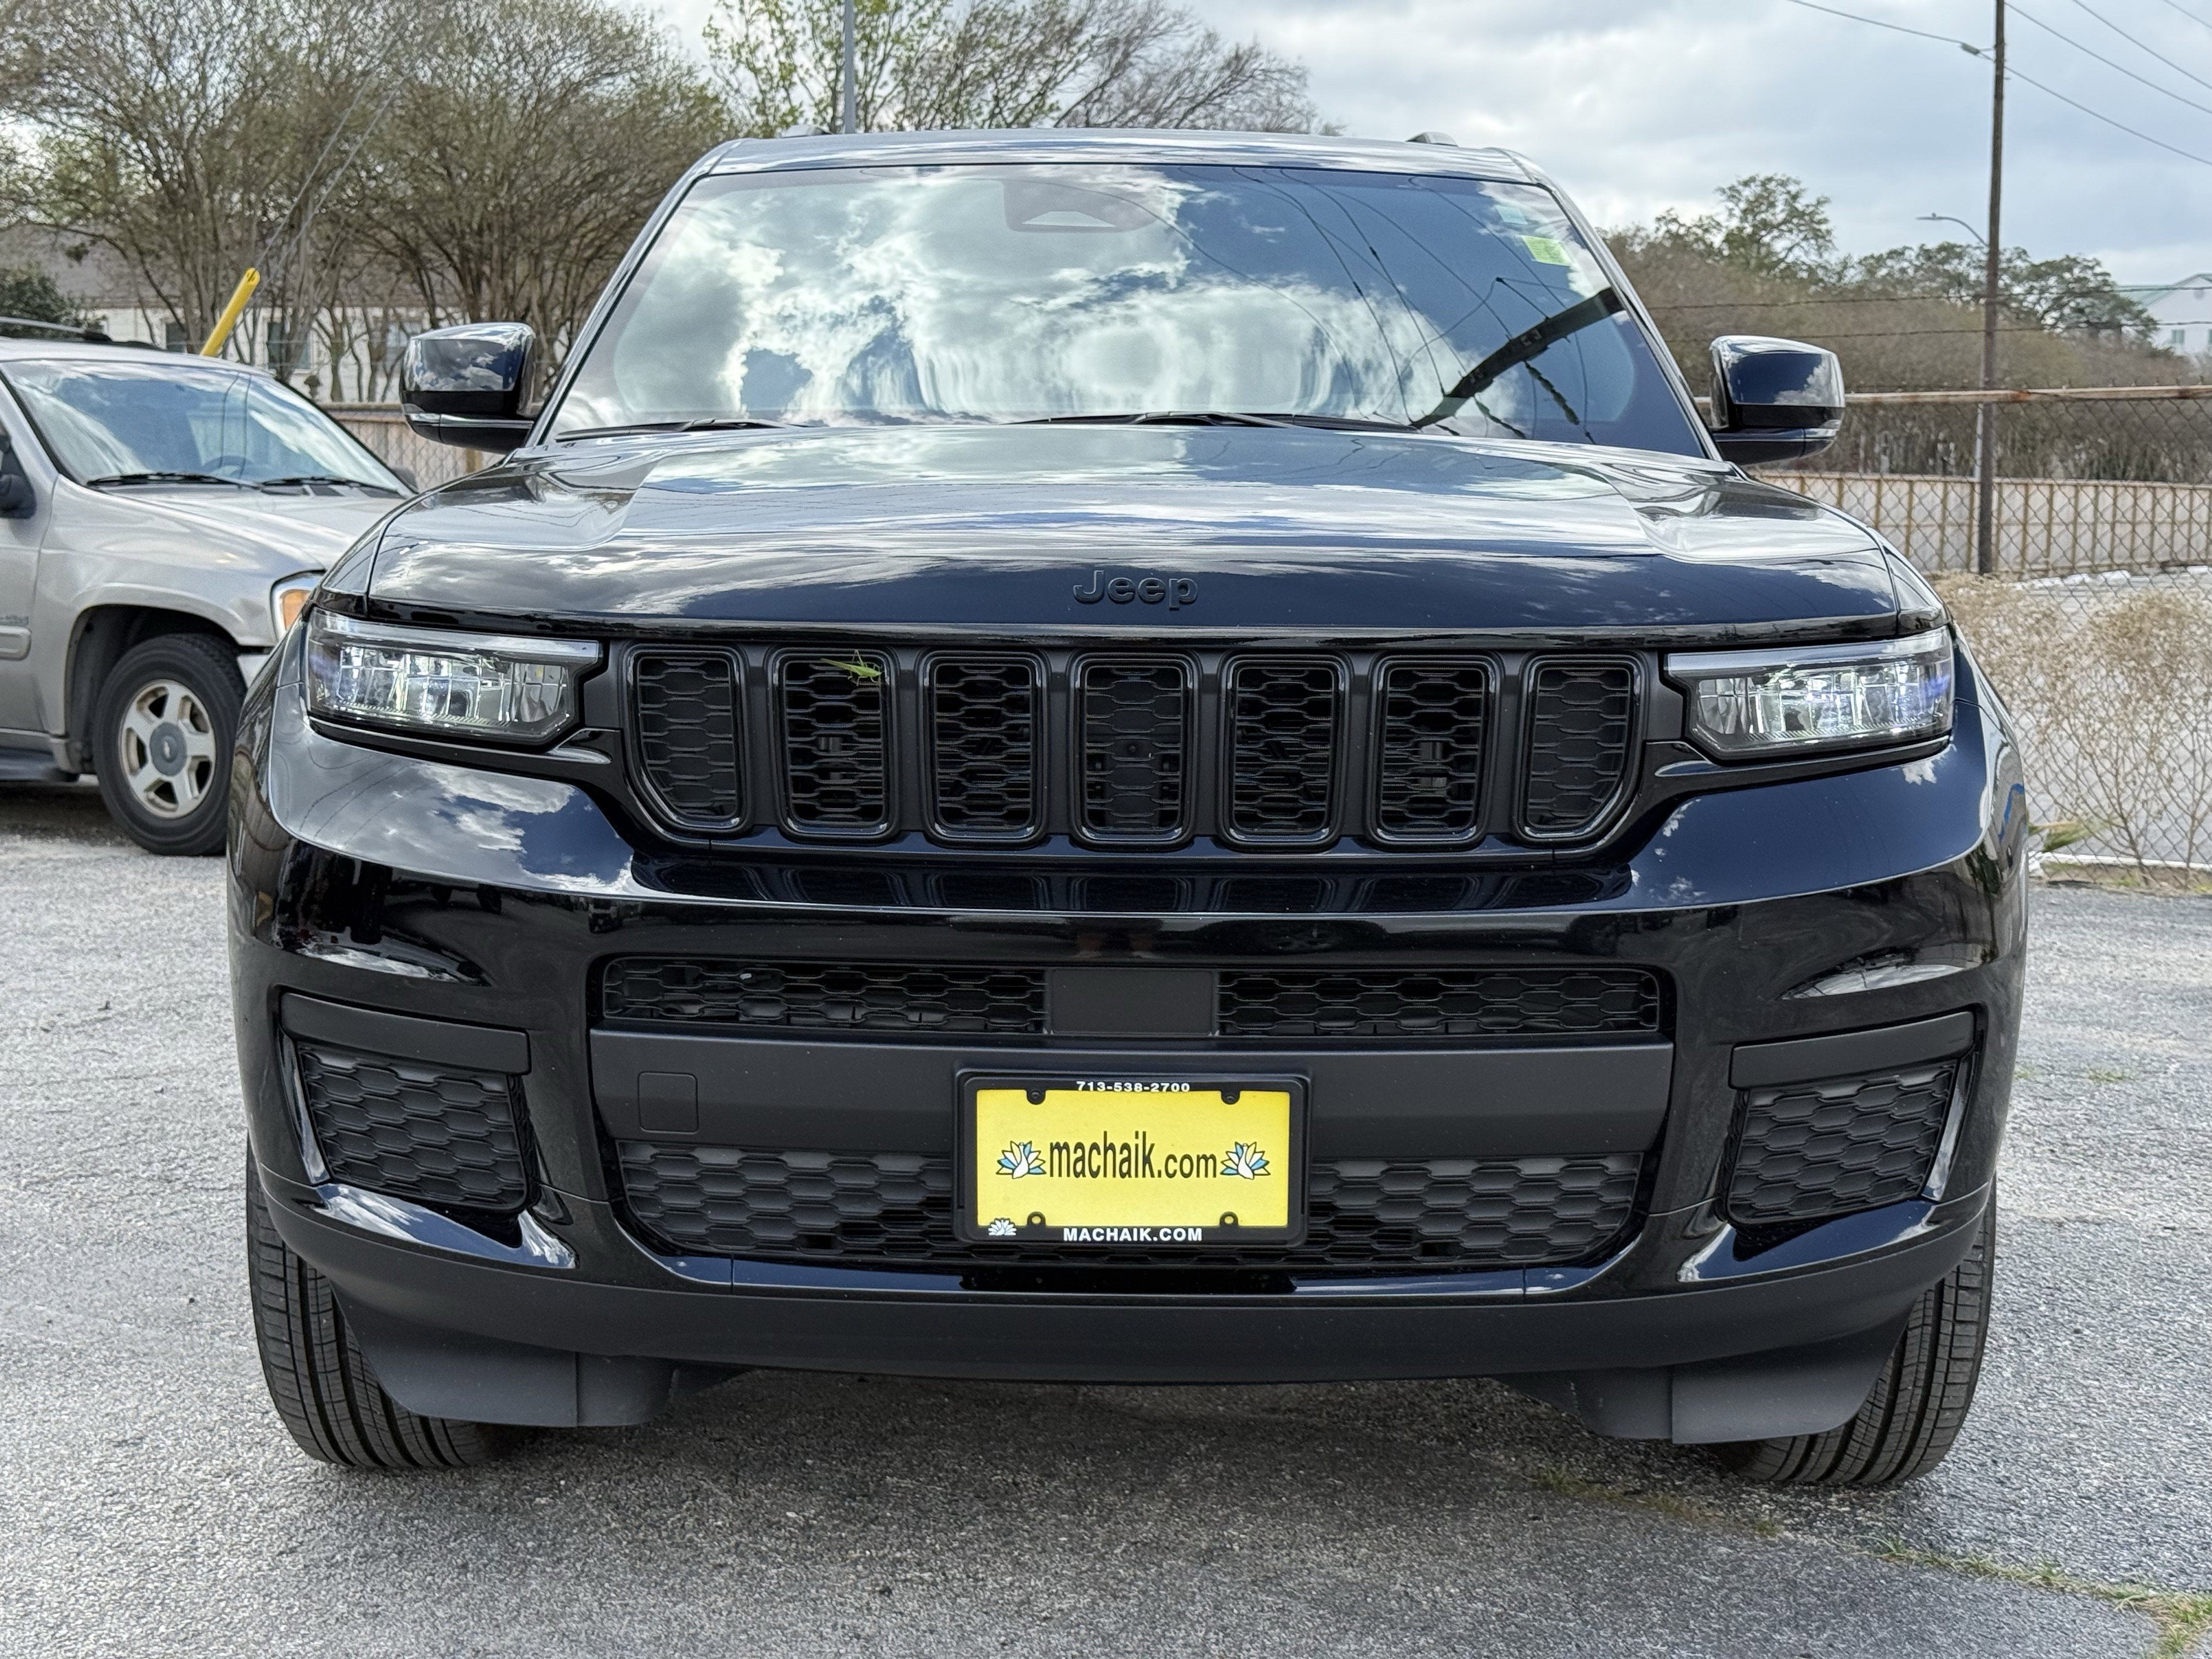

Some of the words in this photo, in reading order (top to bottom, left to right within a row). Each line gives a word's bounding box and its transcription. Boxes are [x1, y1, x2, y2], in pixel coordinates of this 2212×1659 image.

[1073, 570, 1198, 611] Jeep
[1076, 1081, 1190, 1093] 713-538-2700
[1050, 1131, 1217, 1178] machaik.com
[1063, 1227, 1203, 1242] MACHAIK.COM
